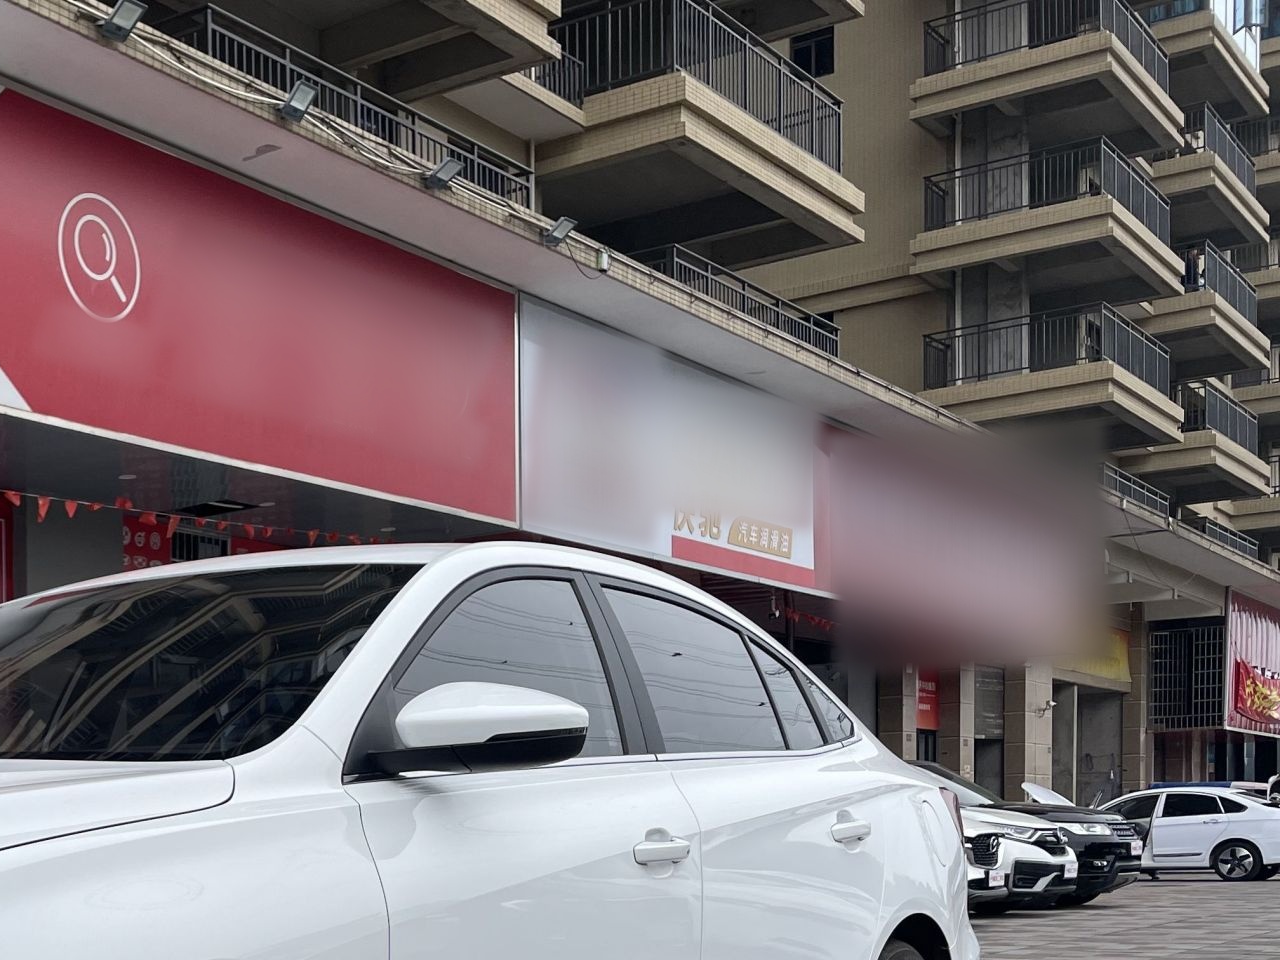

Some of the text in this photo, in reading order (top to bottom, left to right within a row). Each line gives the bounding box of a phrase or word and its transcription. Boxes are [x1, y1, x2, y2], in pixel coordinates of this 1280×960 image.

[738, 520, 789, 553] 汽车润滑油
